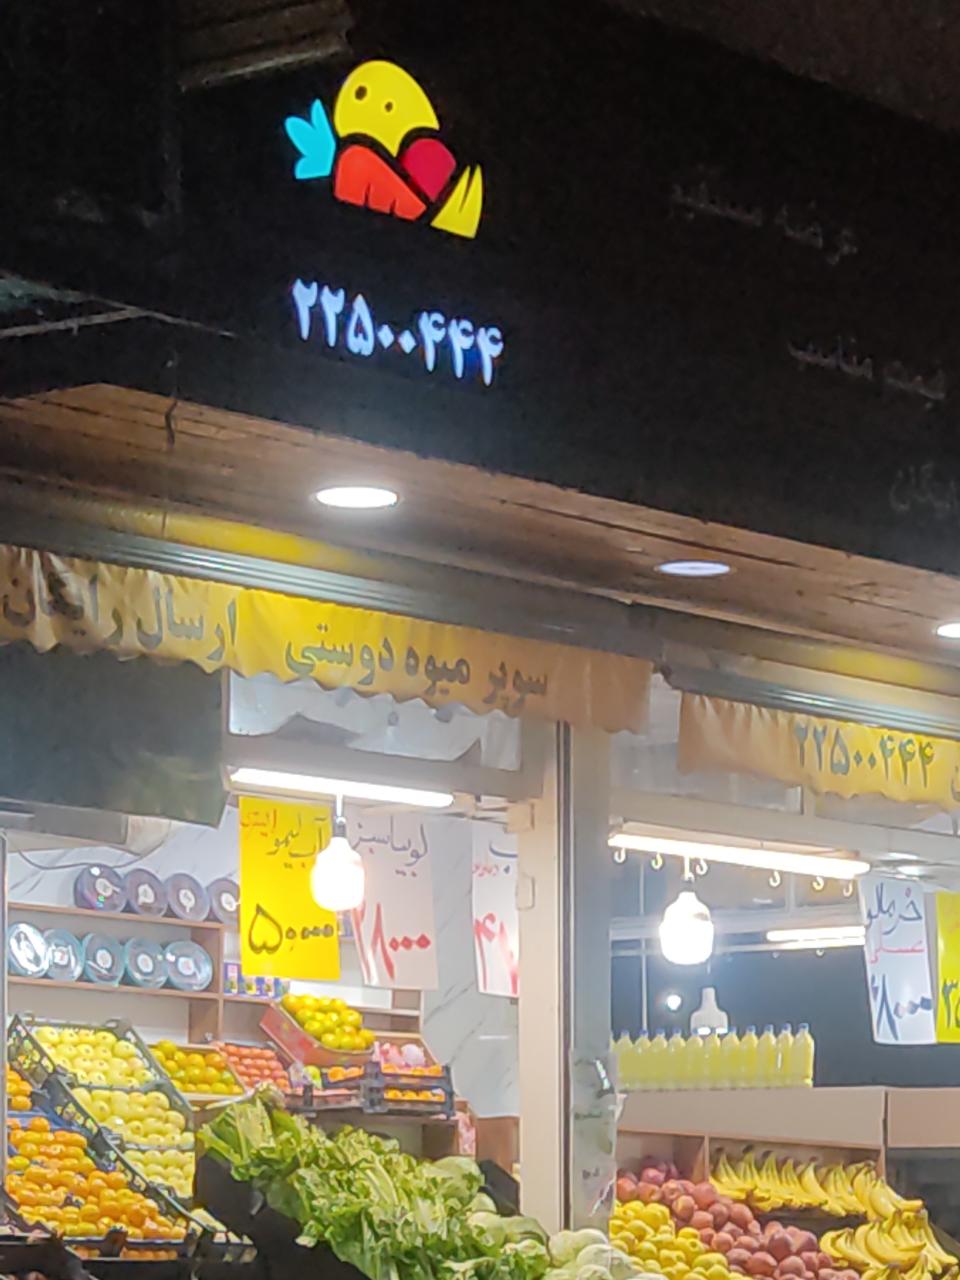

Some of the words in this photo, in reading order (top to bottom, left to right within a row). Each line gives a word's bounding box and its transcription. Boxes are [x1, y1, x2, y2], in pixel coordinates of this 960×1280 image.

[292, 278, 504, 387] ۲۲۵۰۰۴۴۴
[137, 584, 237, 662] ارسال
[285, 624, 395, 686] دوستی
[403, 645, 471, 695] میوه
[483, 660, 548, 708] سوپر
[792, 722, 935, 789] ۲۲۵۰۰۴۴۴
